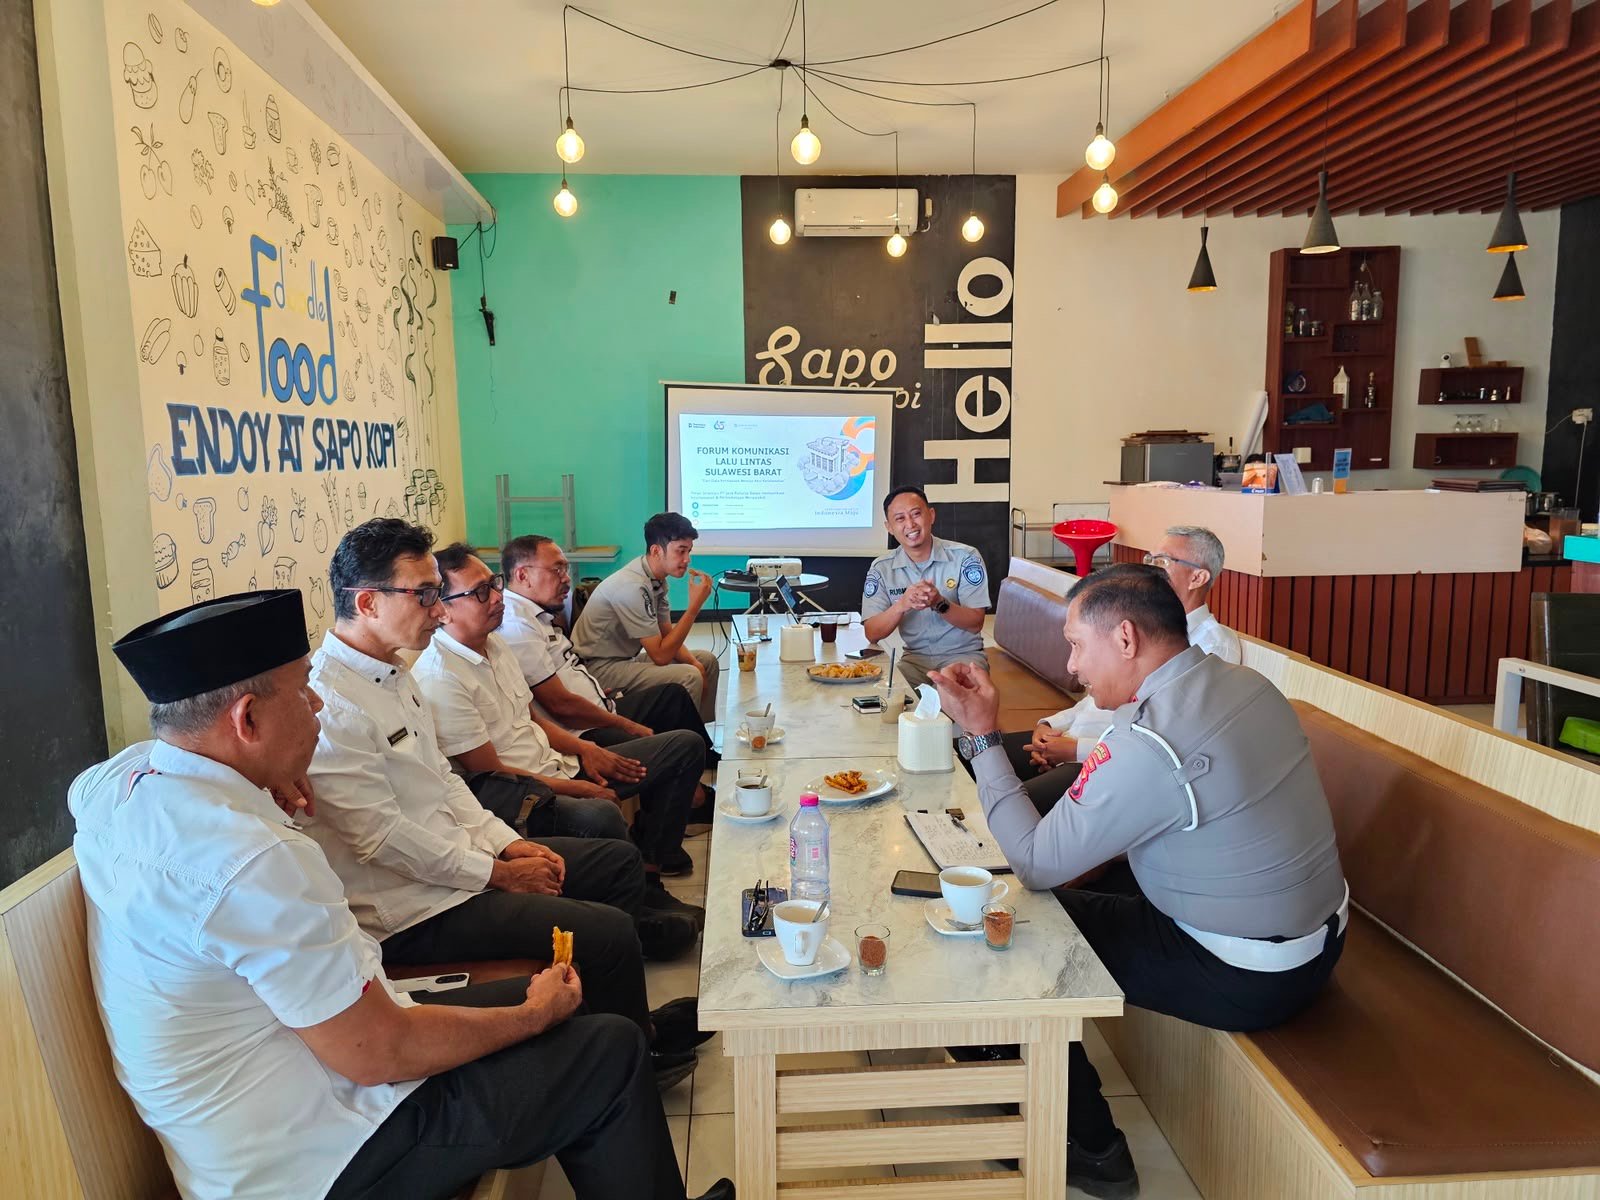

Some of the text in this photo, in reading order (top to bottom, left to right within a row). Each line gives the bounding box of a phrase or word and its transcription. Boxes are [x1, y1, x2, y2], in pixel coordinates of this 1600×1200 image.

[755, 325, 898, 388] Sapo
[923, 256, 1014, 503] Hello
[277, 413, 305, 473] AT
[313, 417, 362, 472] SAPO
[364, 420, 397, 470] KOPI
[696, 446, 790, 456] FORUM KOMUNIKASI
[705, 468, 783, 476] SULAWESI BARAT
[715, 457, 772, 466] LALU LINTAS
